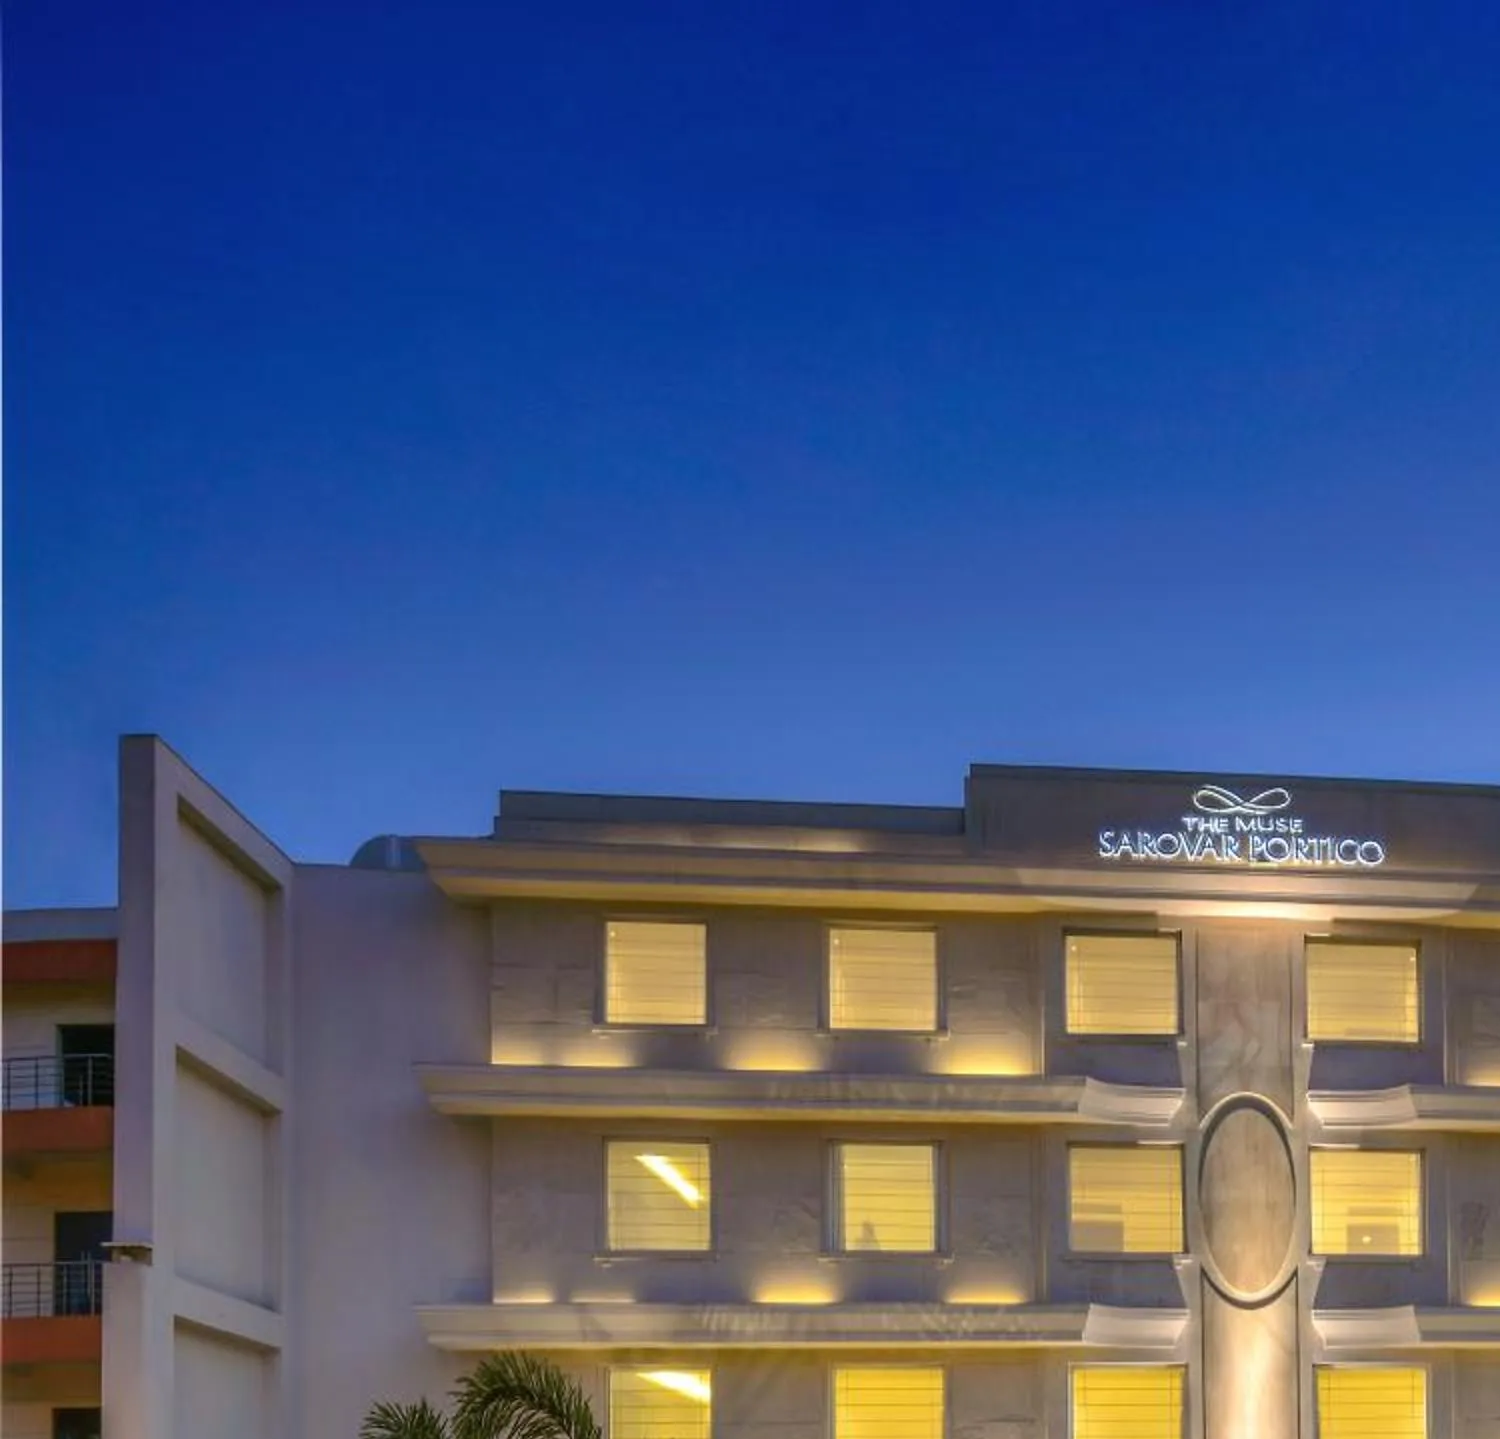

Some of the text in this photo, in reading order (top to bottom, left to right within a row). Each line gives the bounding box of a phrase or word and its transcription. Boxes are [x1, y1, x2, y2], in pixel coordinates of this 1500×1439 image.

[1182, 816, 1303, 833] THE MUSE
[1099, 830, 1385, 866] SAROVAR PORTICO
